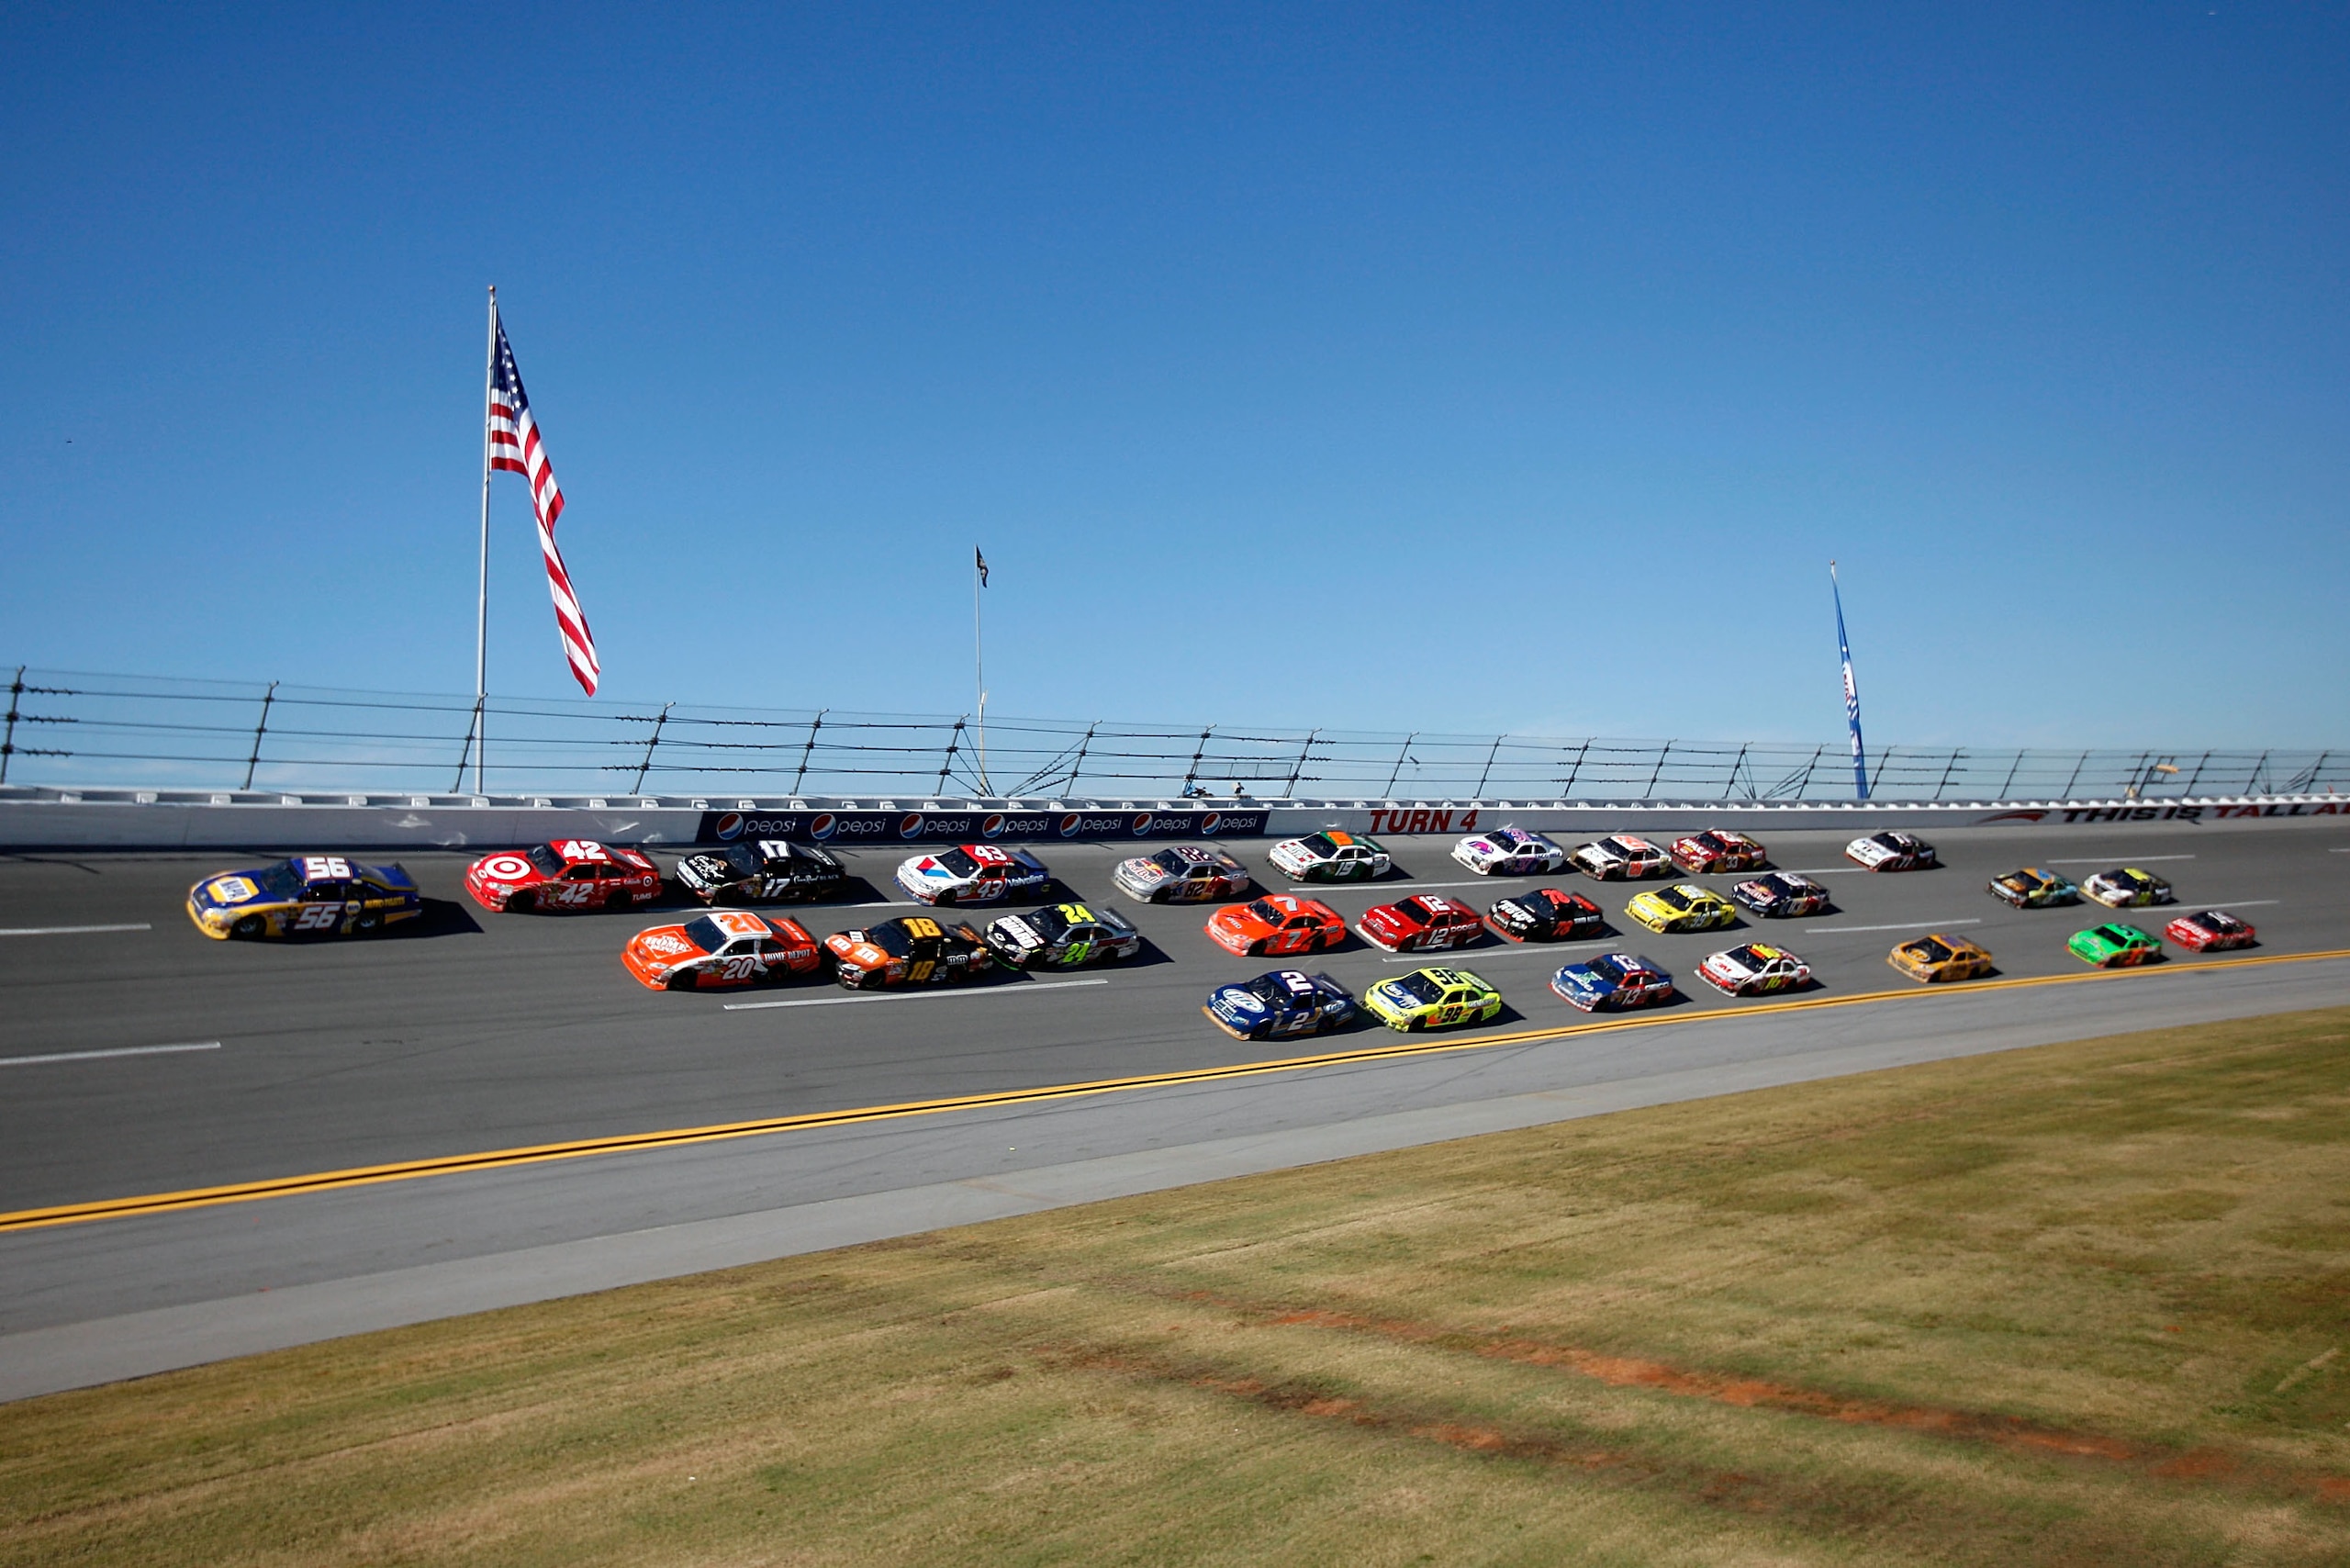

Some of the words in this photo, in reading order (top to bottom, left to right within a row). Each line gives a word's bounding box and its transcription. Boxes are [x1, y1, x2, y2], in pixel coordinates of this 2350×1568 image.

[1370, 809, 1453, 833] TURN
[1460, 809, 1479, 832] 4
[2063, 808, 2159, 823] THIS
[2165, 807, 2201, 820] IS
[2214, 802, 2350, 818] TALLA
[744, 818, 796, 834] pepsi
[836, 818, 887, 834] pepsi
[923, 818, 970, 834] pepsi
[1005, 817, 1049, 833] pepsi
[1081, 817, 1122, 833] pepsi
[1152, 816, 1192, 831] pepsi
[1220, 815, 1257, 830] pepsi
[562, 840, 607, 860] 42
[758, 840, 790, 858] 17
[974, 845, 1008, 862] 43
[306, 857, 352, 879] 56
[688, 859, 711, 879] BLACK
[1334, 861, 1357, 877] 19
[1726, 856, 1739, 868] 33
[761, 878, 791, 898] 17
[977, 880, 1003, 899] 43
[1007, 874, 1044, 888] Valvoline
[1184, 881, 1206, 898] 82
[220, 880, 250, 901] NAPA
[558, 883, 594, 904] 42
[632, 892, 652, 901] TUMS
[1274, 897, 1298, 912] 7
[1419, 895, 1451, 912] 12
[295, 904, 341, 930] 56
[1058, 903, 1097, 924] 24
[1373, 908, 1402, 927] DODGE
[1691, 913, 1707, 927] 99
[720, 913, 767, 934] 20
[902, 918, 942, 938] 18
[1449, 923, 1478, 934] DODGE
[995, 918, 1038, 949] GUARD
[1285, 931, 1302, 948] 7
[1427, 927, 1449, 946] 12
[645, 936, 691, 952] HOME
[1062, 942, 1091, 963] 24
[764, 951, 786, 962] HOME
[788, 949, 811, 960] DEPOT
[1612, 954, 1641, 970] 13
[722, 957, 757, 980] 20
[907, 961, 936, 981] 18
[1281, 971, 1314, 992] 2
[1429, 969, 1464, 986] 98
[1765, 976, 1782, 991] 16
[1621, 989, 1641, 1005] 13
[1287, 1012, 1310, 1031] 2
[1442, 1005, 1463, 1023] 98
